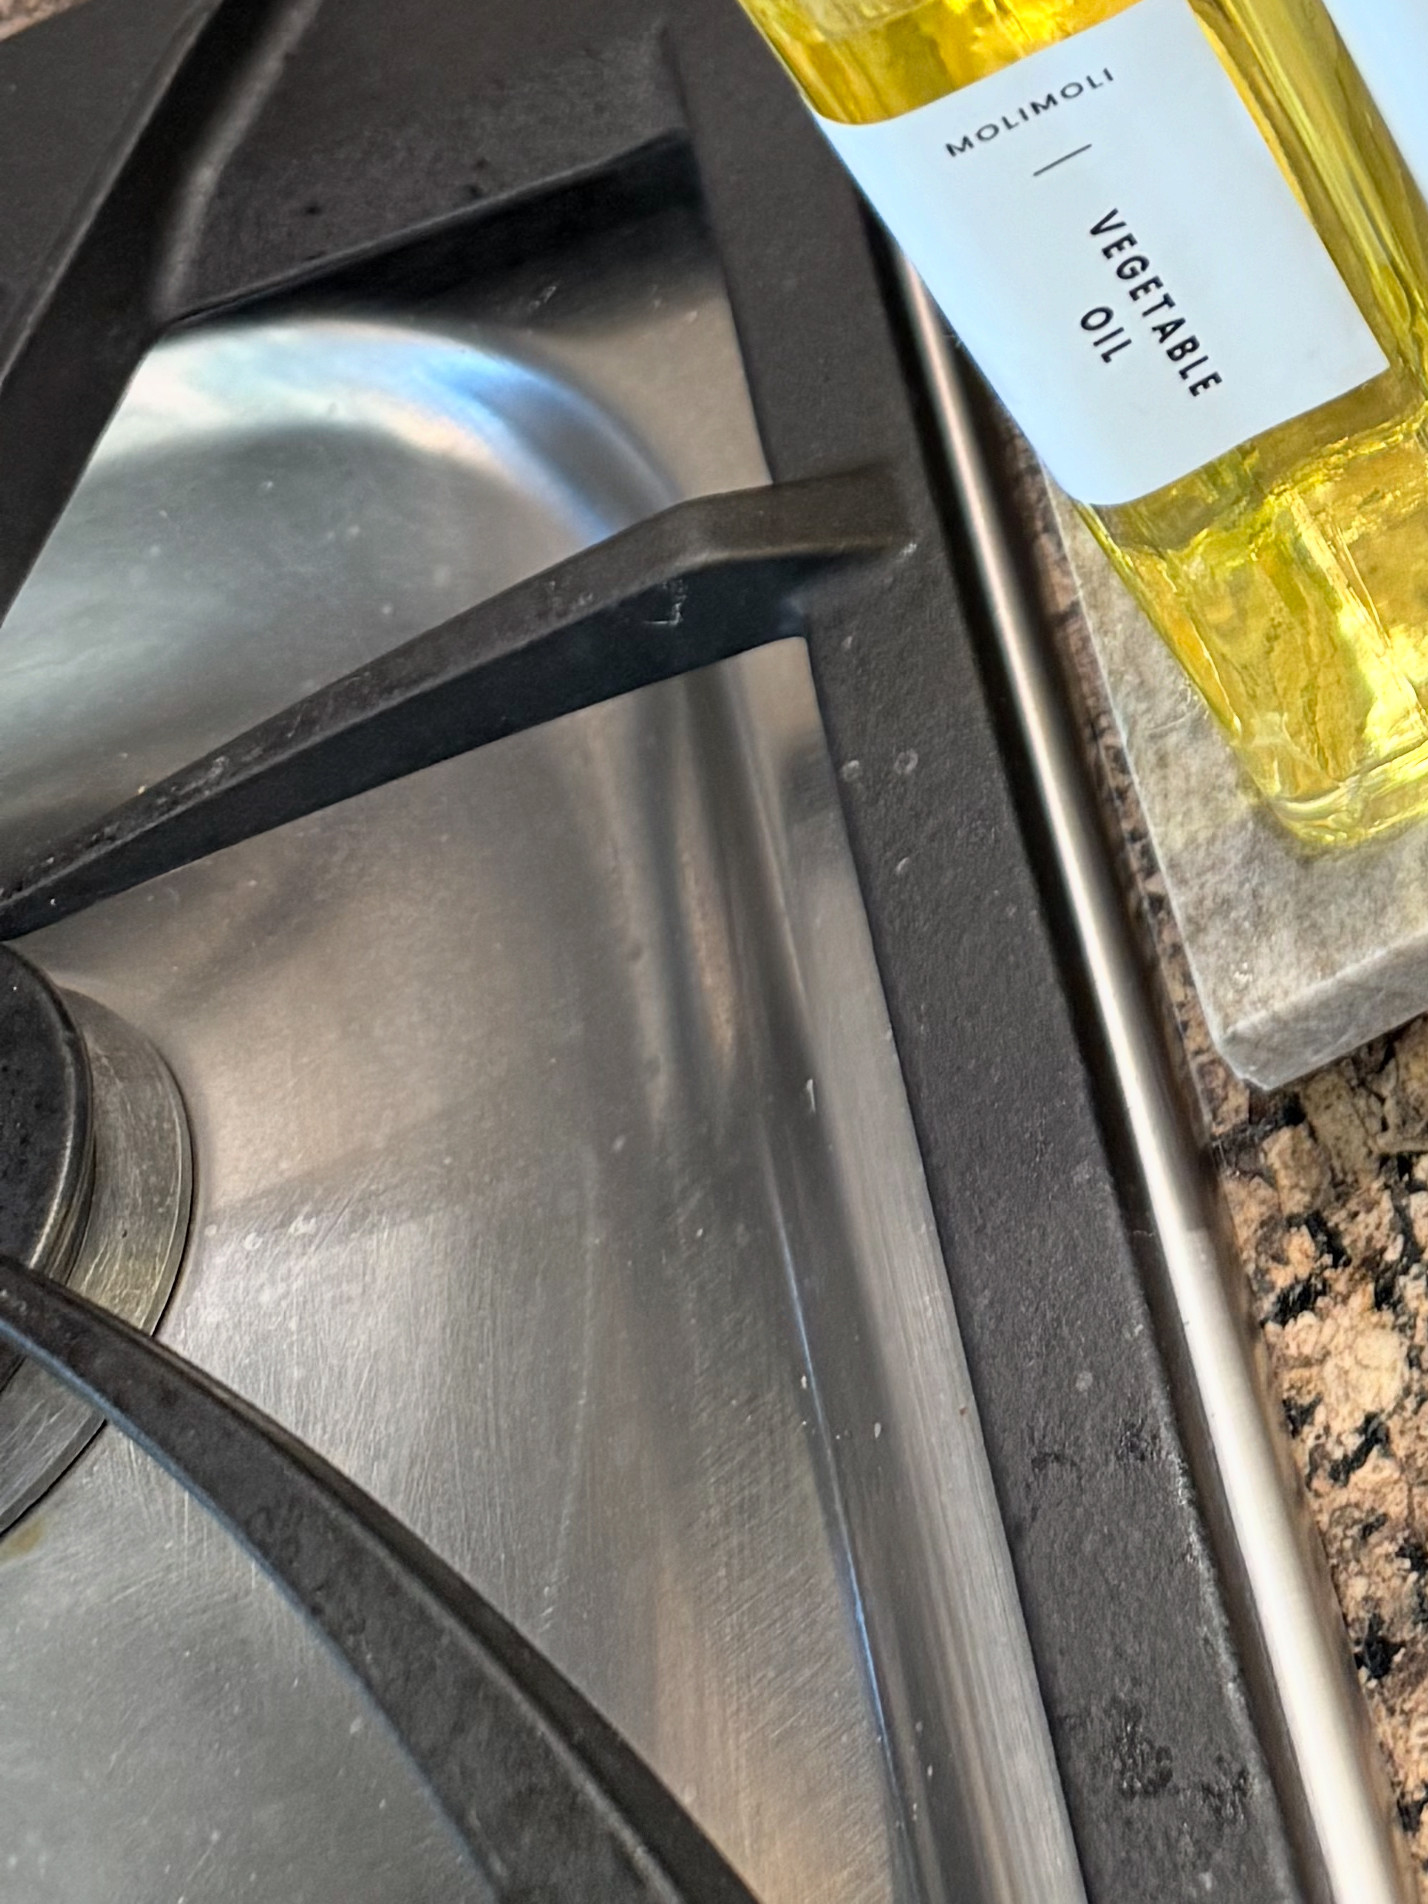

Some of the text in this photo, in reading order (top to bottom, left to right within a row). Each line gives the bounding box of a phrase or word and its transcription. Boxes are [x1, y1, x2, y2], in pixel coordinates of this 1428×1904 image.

[944, 67, 1115, 158] MOLIMOLI
[1079, 305, 1133, 365] OIL
[1088, 207, 1224, 398] VEGETABLE
